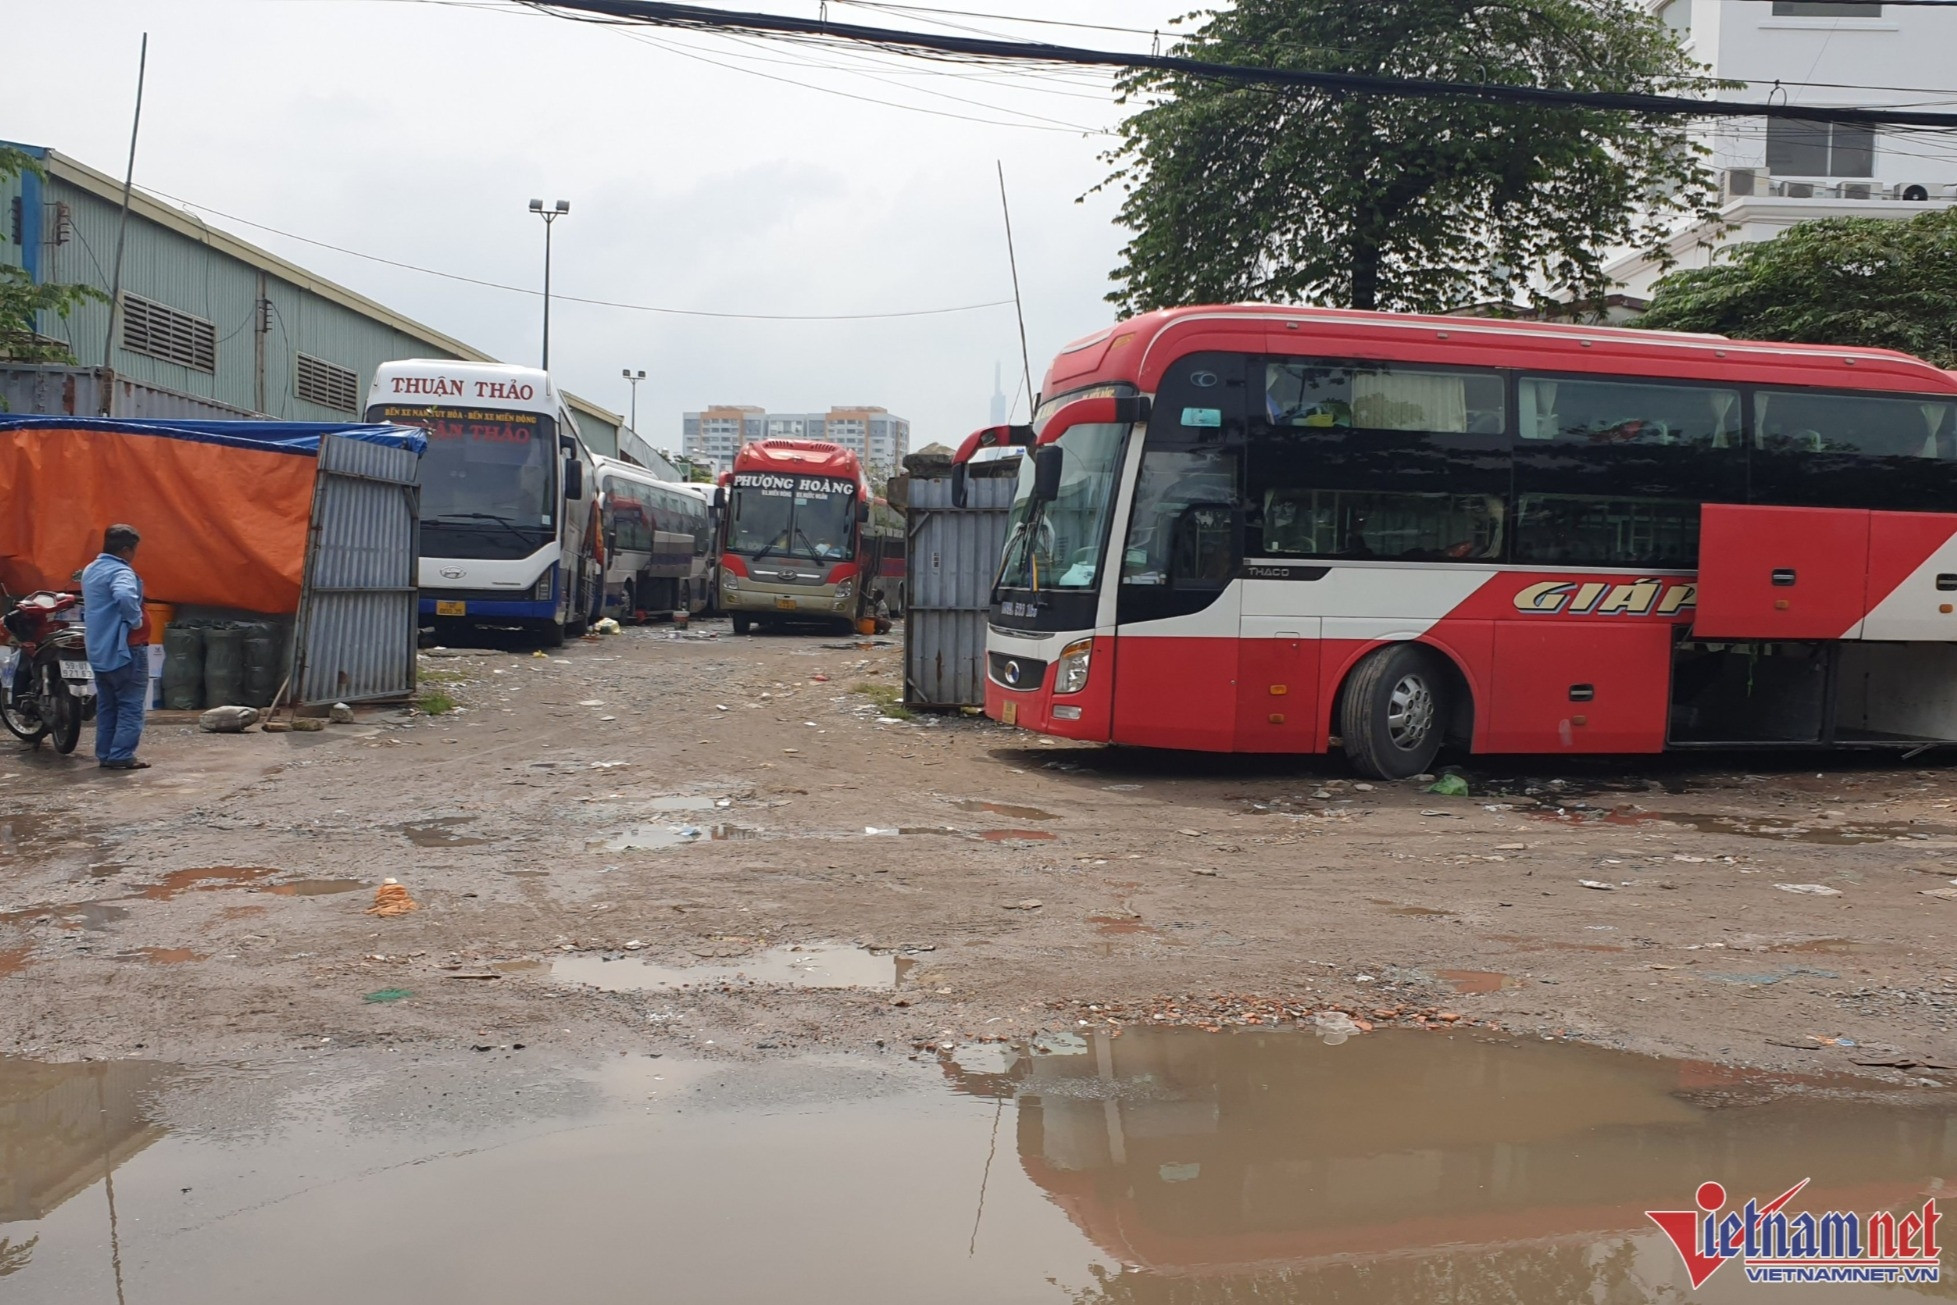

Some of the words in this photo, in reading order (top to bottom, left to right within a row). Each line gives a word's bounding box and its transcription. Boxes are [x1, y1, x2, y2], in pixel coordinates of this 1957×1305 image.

[391, 376, 464, 397] THUẬN
[475, 379, 534, 400] THẢO
[401, 408, 411, 416] XE
[485, 413, 494, 421] XE
[733, 474, 794, 490] PHƯỢNG
[799, 478, 854, 495] HOÀNG
[1248, 567, 1290, 577] THACO
